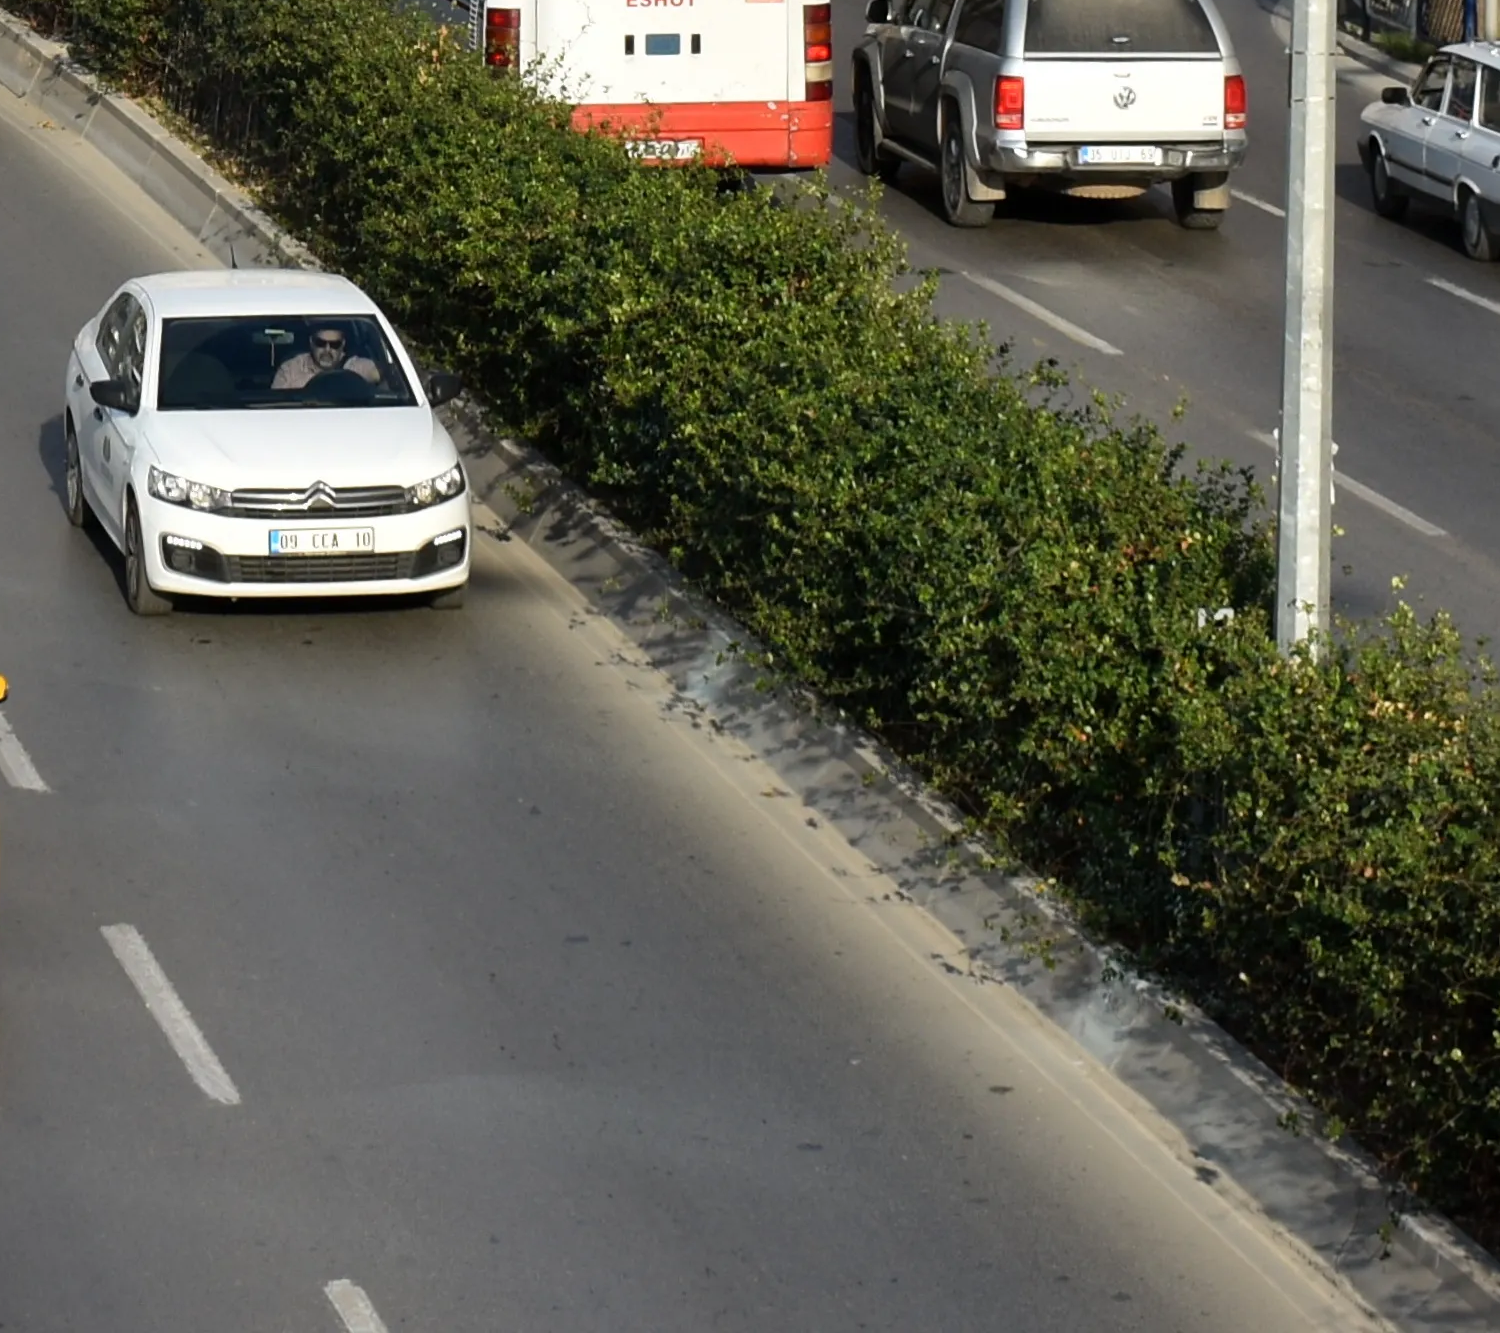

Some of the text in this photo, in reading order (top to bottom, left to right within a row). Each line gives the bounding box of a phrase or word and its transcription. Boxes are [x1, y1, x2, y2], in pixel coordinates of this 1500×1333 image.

[280, 531, 371, 549] 09 CCA 10
